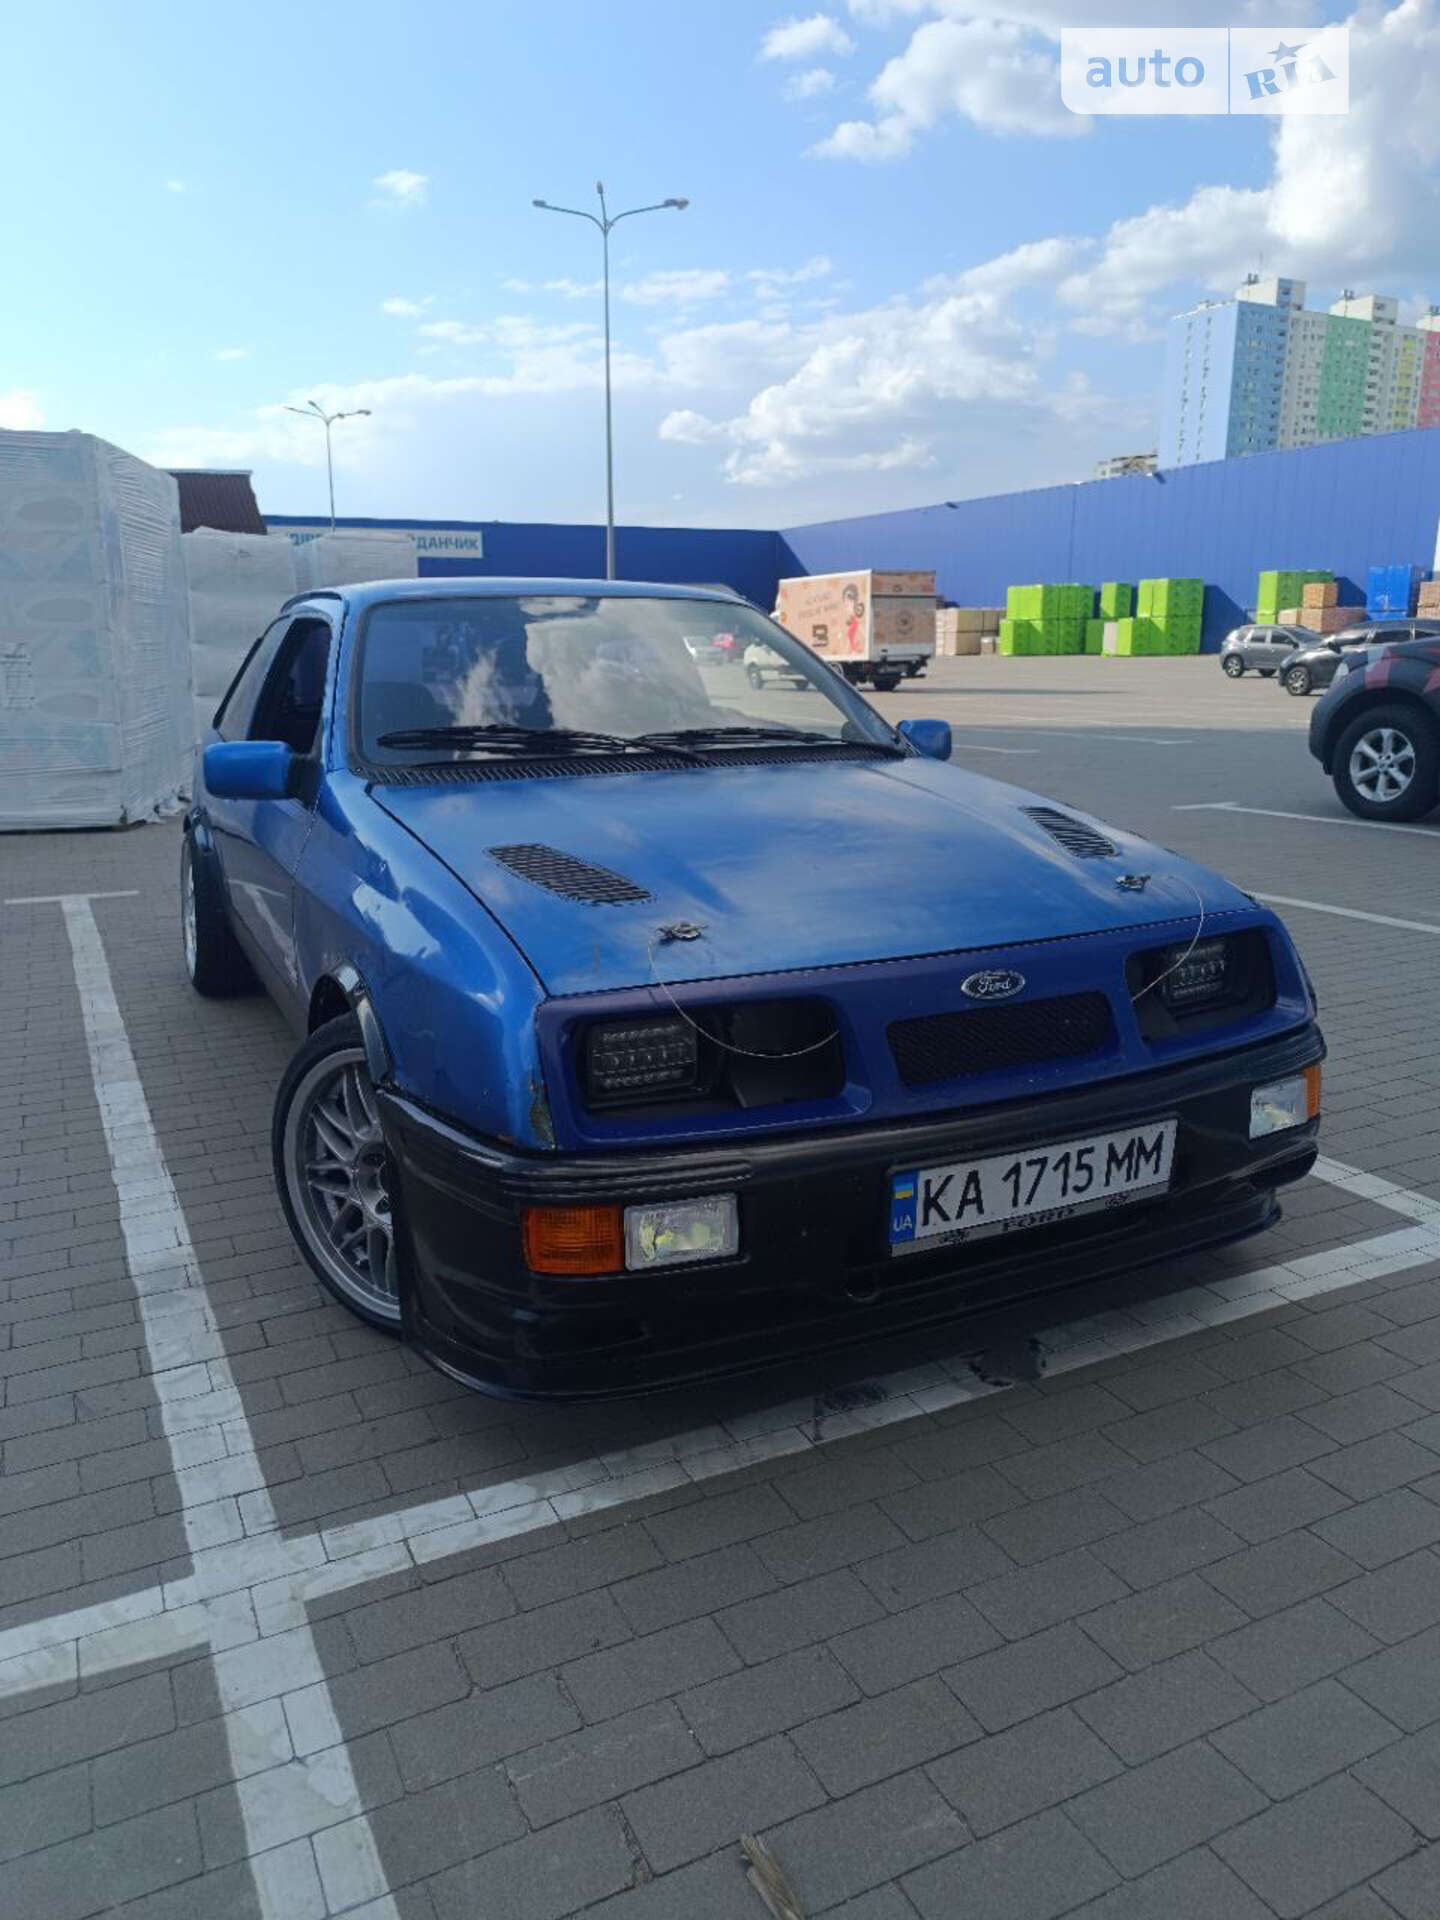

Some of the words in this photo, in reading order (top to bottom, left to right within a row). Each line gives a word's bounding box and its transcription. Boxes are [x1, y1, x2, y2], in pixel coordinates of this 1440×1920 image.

[921, 1169, 985, 1226] KA
[1001, 1147, 1095, 1209] 1715
[1104, 1131, 1164, 1187] MM
[893, 1214, 913, 1232] UA
